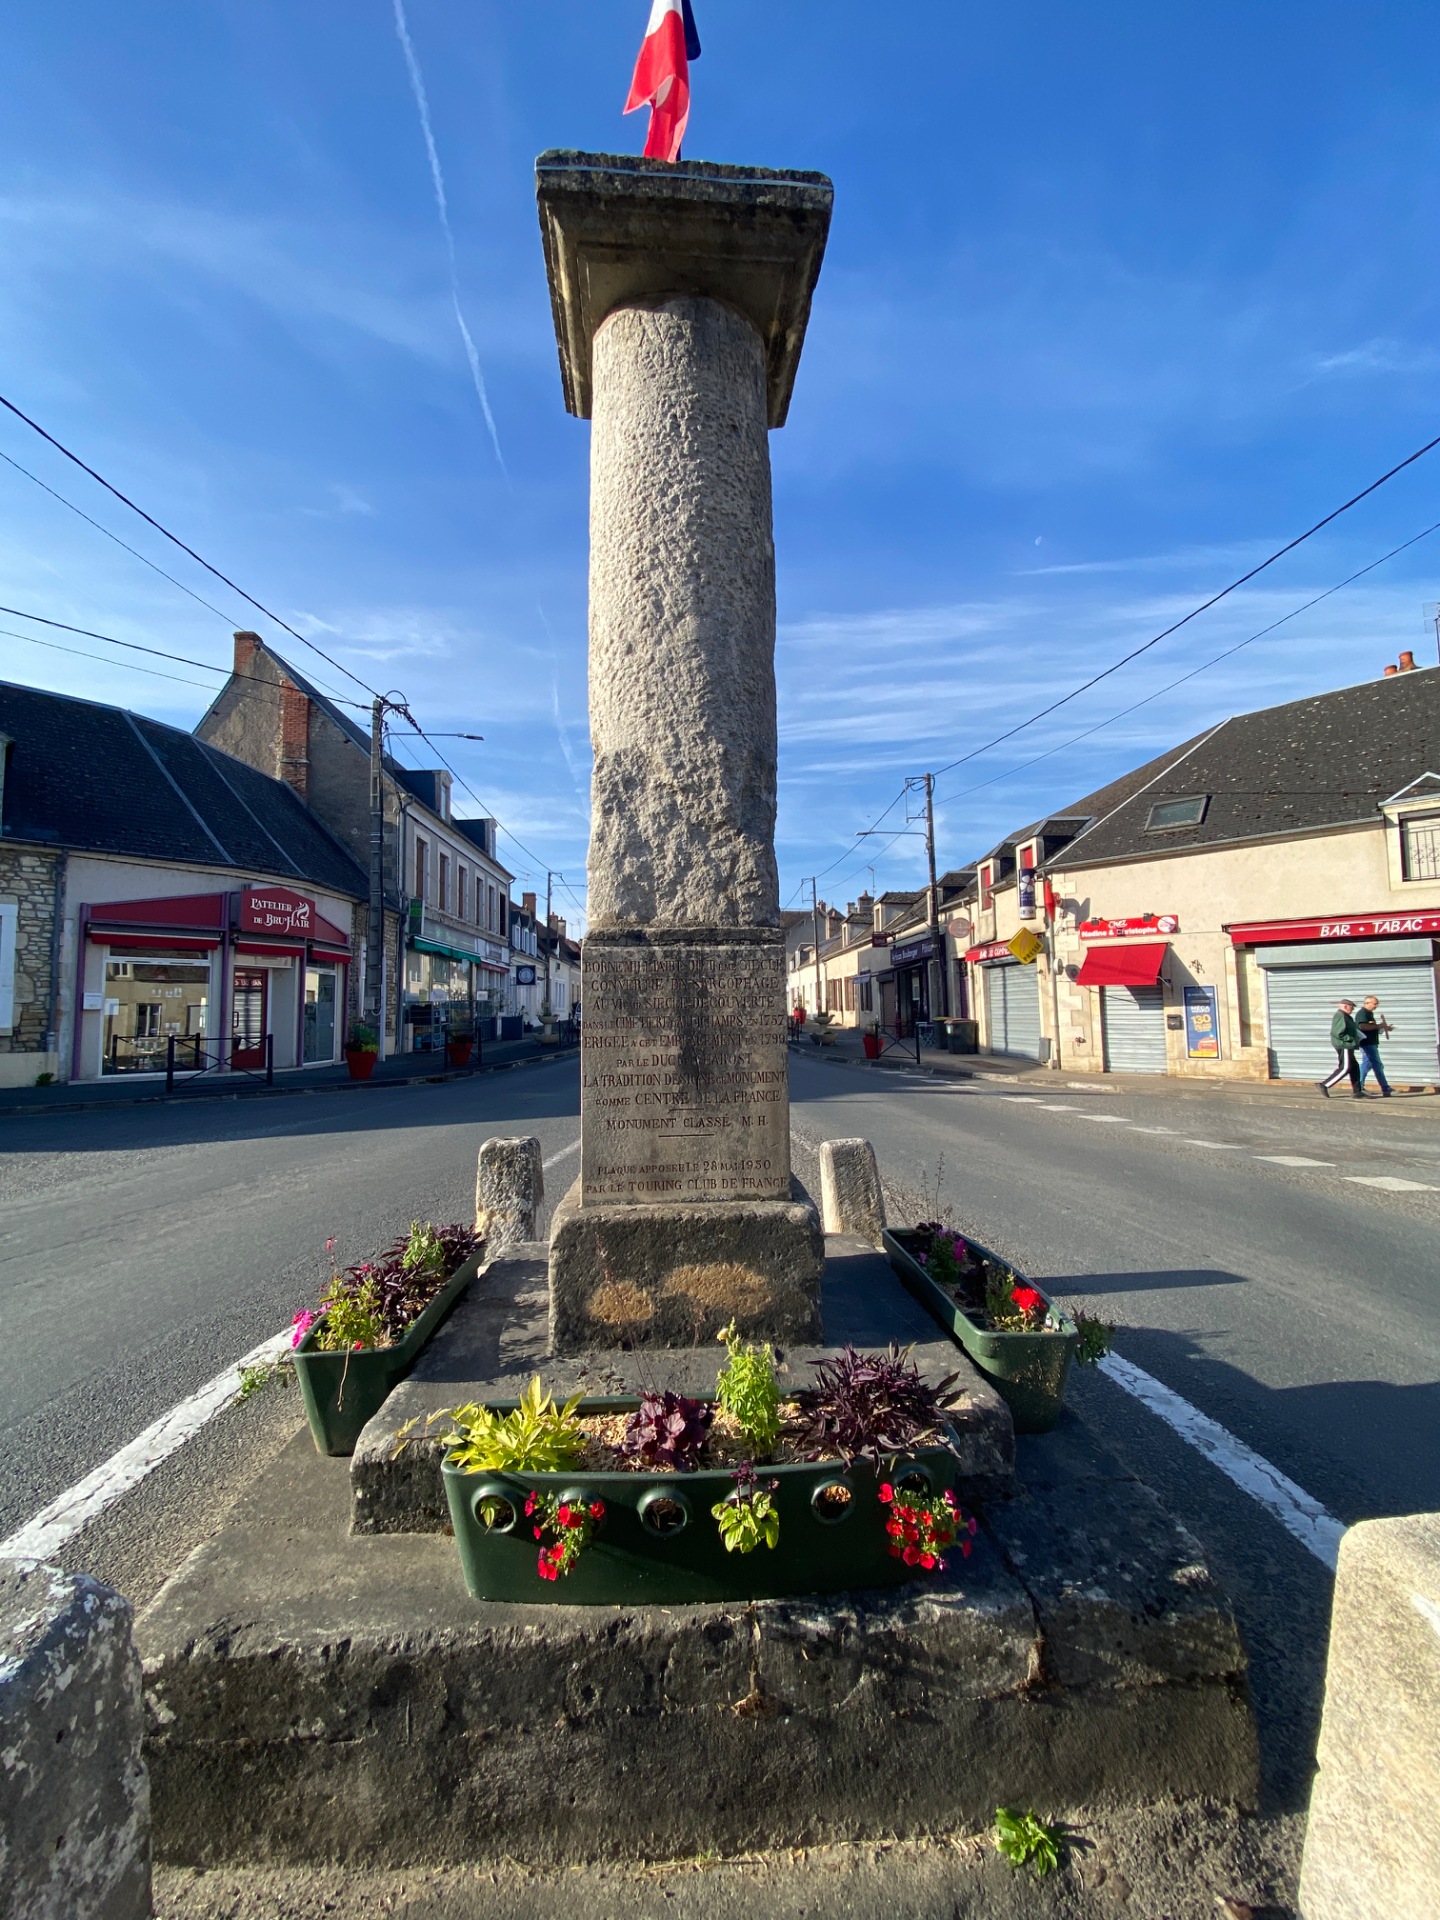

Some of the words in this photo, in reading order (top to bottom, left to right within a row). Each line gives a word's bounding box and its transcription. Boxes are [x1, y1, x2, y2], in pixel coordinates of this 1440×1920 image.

[1108, 919, 1128, 929] Chez
[1320, 924, 1351, 937] BAR
[1372, 919, 1423, 933] TABAC
[1081, 930, 1107, 938] Nadine
[1116, 927, 1157, 936] Christophe
[1022, 941, 1042, 962] PRESSE
[584, 960, 623, 973] BORNE
[591, 978, 664, 991] CONVERTIE
[583, 1020, 604, 1029] DANS
[746, 1019, 758, 1027] EN
[759, 1014, 785, 1026] 1757
[584, 1035, 629, 1048] ERIGEE
[639, 1038, 658, 1047] CET
[745, 1037, 757, 1046] EN
[759, 1033, 786, 1045] 1799
[617, 1059, 634, 1068] PAR
[636, 1058, 649, 1067] LE
[651, 1053, 676, 1067] DUC
[584, 1075, 599, 1088] LA
[600, 1073, 661, 1087] TRADITION
[726, 1070, 786, 1085] MONUMENT
[595, 1097, 631, 1107] COMME
[635, 1091, 690, 1105] CENTRE
[695, 1091, 712, 1104] DE
[715, 1091, 731, 1104] LA
[733, 1090, 781, 1104] FRANCE
[606, 1117, 677, 1131] MONUMENT
[683, 1113, 732, 1128] CLASSÉ
[598, 1165, 636, 1176] PLAQUE
[638, 1163, 685, 1174] APPOSEE
[686, 1162, 699, 1172] LE
[703, 1160, 718, 1172] 28
[720, 1162, 738, 1171] MAI
[740, 1159, 771, 1171] 1950
[586, 1184, 606, 1194] PAR
[610, 1182, 624, 1193] LE
[628, 1179, 682, 1192] TOURING
[687, 1178, 717, 1190] CLUB
[721, 1178, 738, 1189] DE
[741, 1176, 788, 1189] FRANCE
